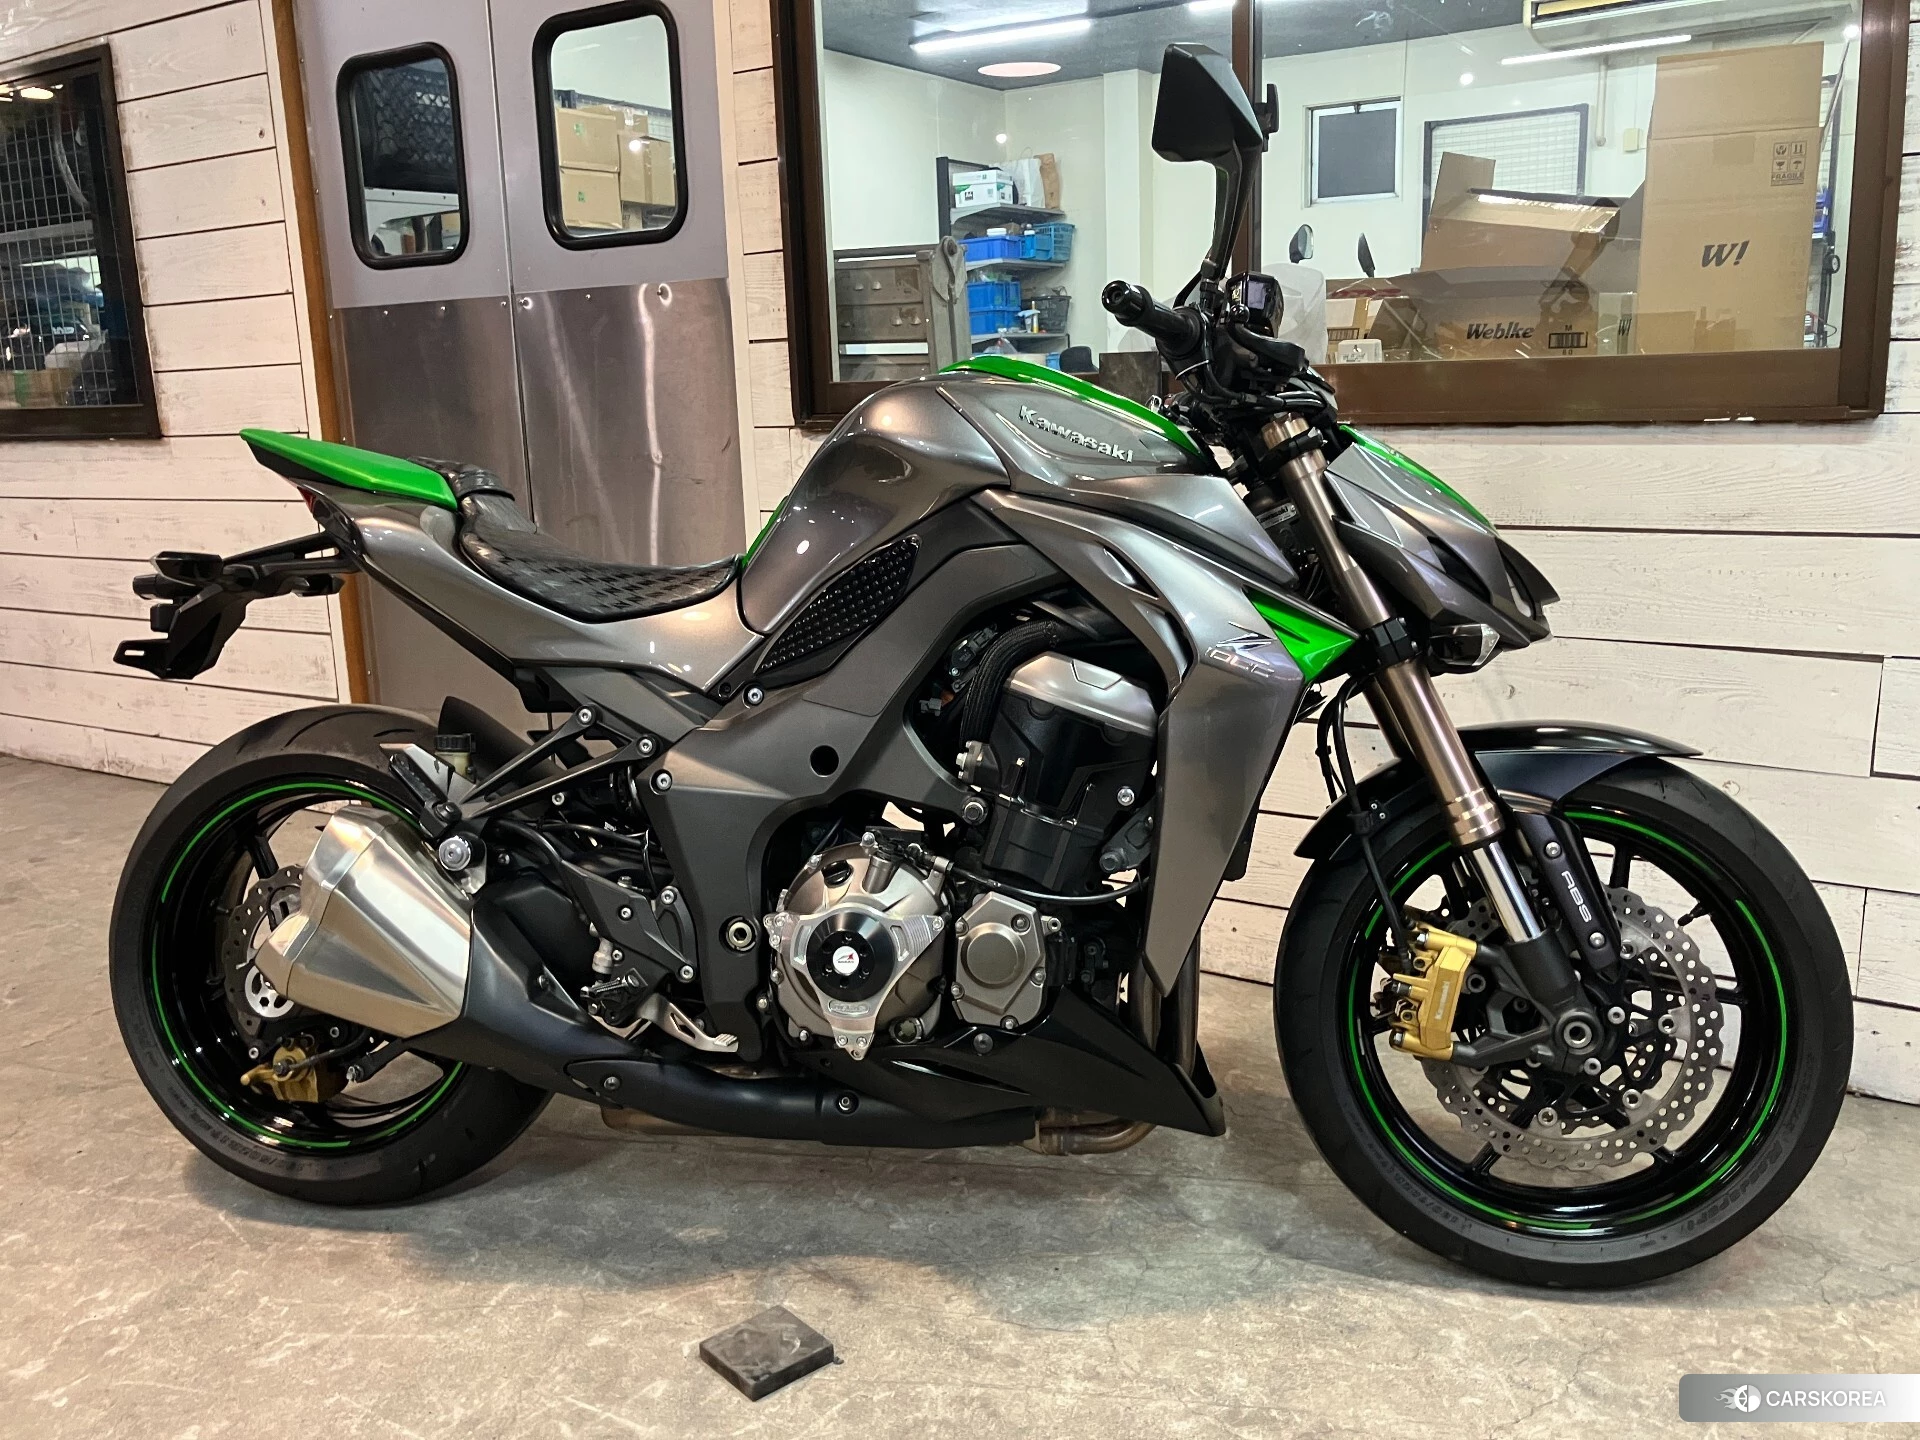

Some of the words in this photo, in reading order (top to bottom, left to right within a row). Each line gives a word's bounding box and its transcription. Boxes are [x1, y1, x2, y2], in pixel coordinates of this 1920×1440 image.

[1702, 240, 1750, 267] W!
[1019, 405, 1134, 463] Kawasaki
[1561, 870, 1592, 923] ABS
